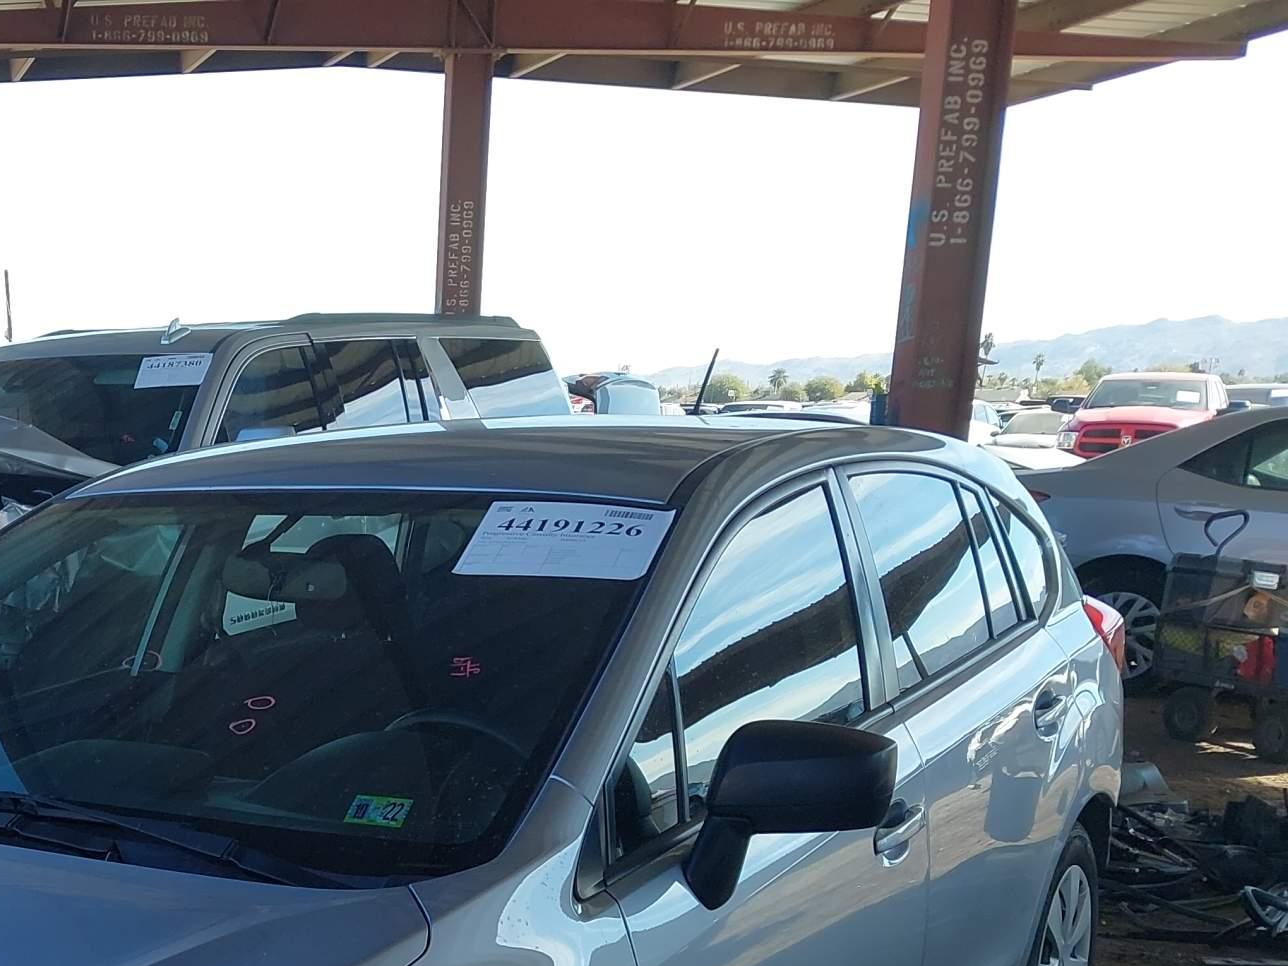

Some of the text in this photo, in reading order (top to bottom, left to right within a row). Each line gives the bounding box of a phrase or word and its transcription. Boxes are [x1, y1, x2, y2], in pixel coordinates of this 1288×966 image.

[928, 37, 969, 247] U.S. PREFAB INC.
[950, 39, 989, 244] 1-866-799-0969
[450, 199, 462, 226] INC.
[447, 233, 460, 287] PREFAB
[458, 200, 474, 313] -866-799-0969
[497, 517, 644, 538] 44191226
